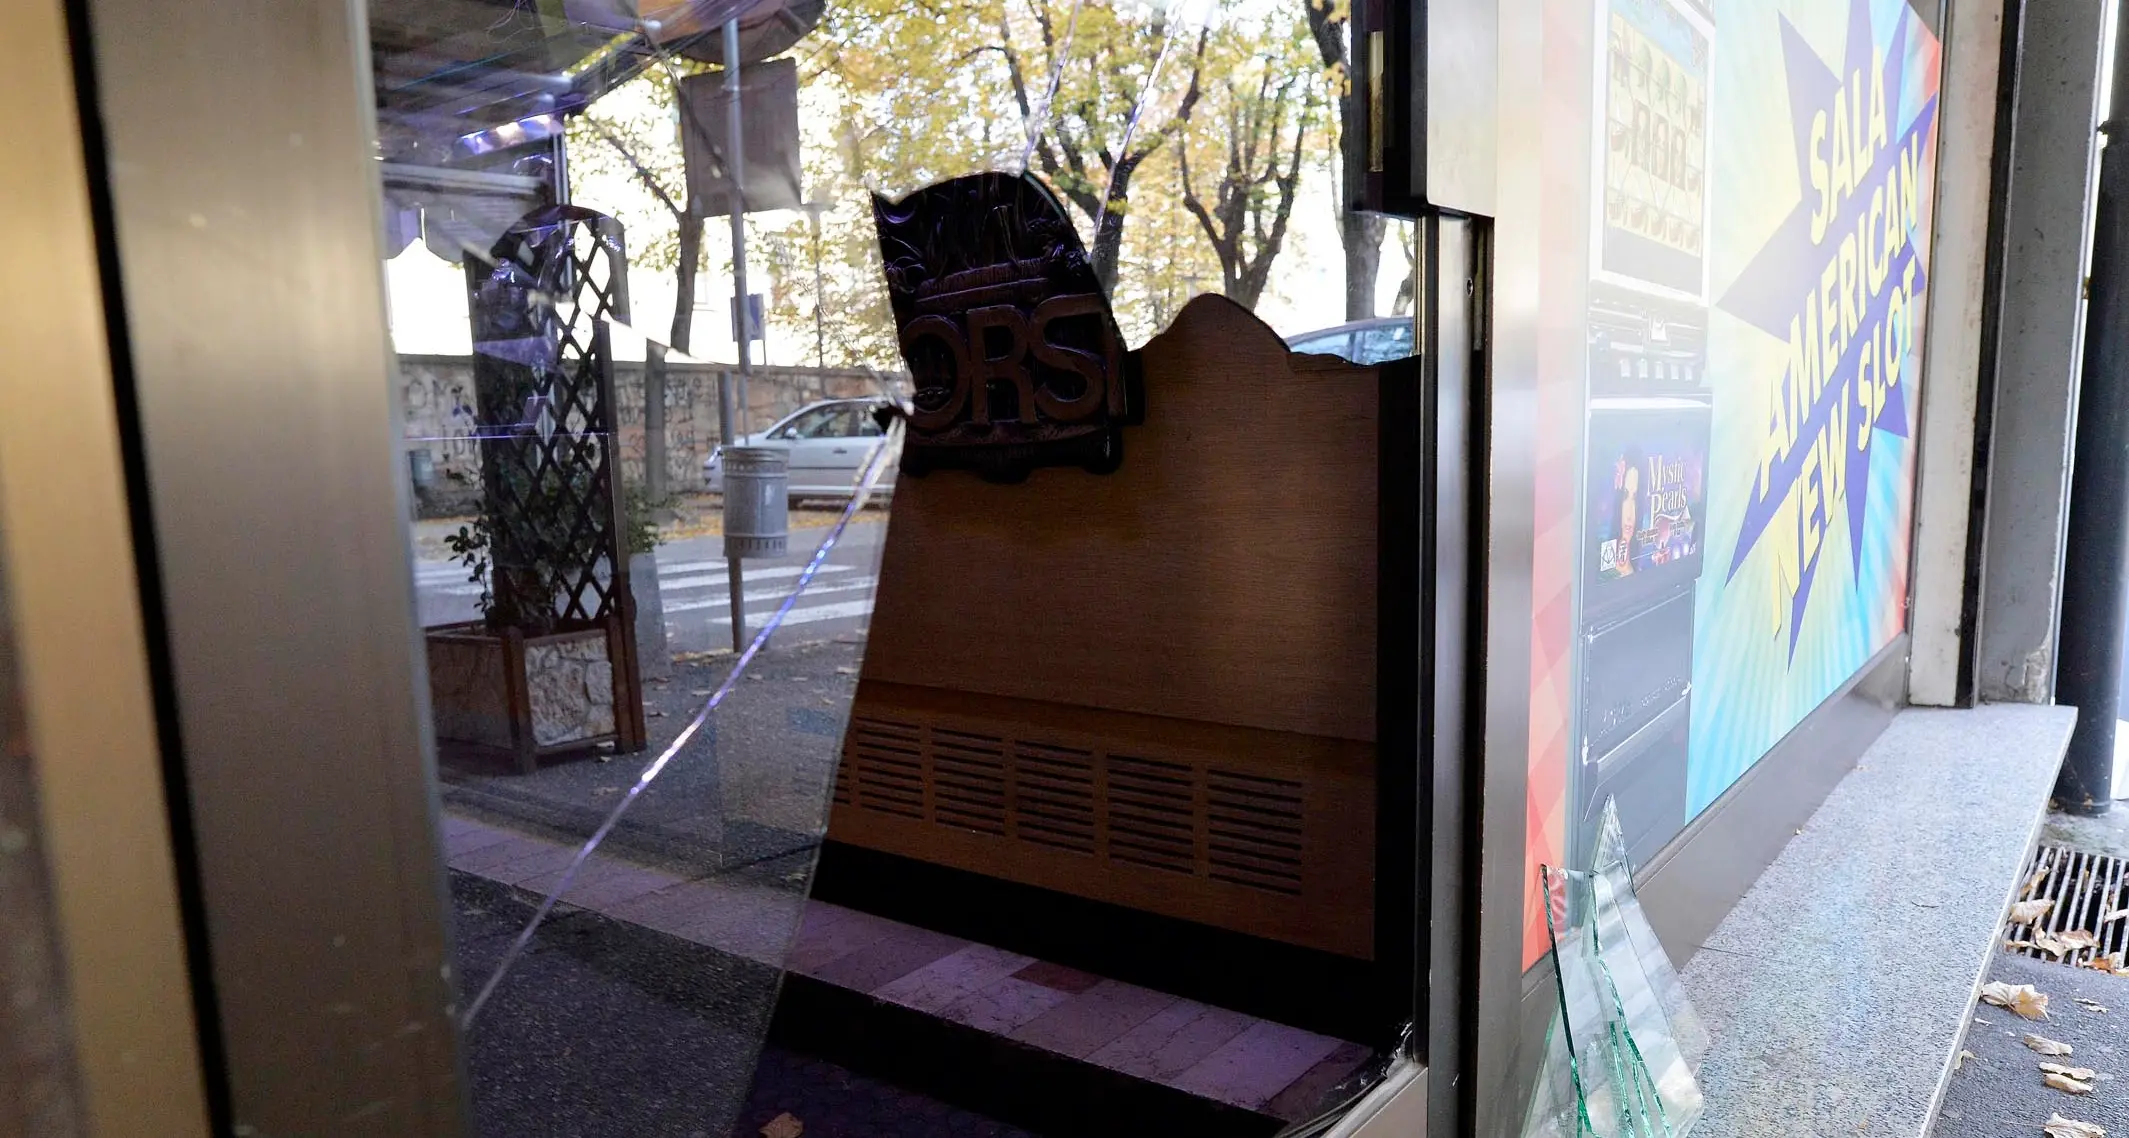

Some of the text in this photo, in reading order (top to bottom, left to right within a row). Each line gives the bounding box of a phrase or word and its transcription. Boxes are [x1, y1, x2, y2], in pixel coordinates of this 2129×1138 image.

[1810, 44, 1887, 246] SALA
[1759, 129, 1919, 503] AMERICAN
[1647, 454, 1687, 497] Mystic
[1648, 484, 1688, 529] Pearls
[1771, 253, 1916, 641] NEW SLOT
